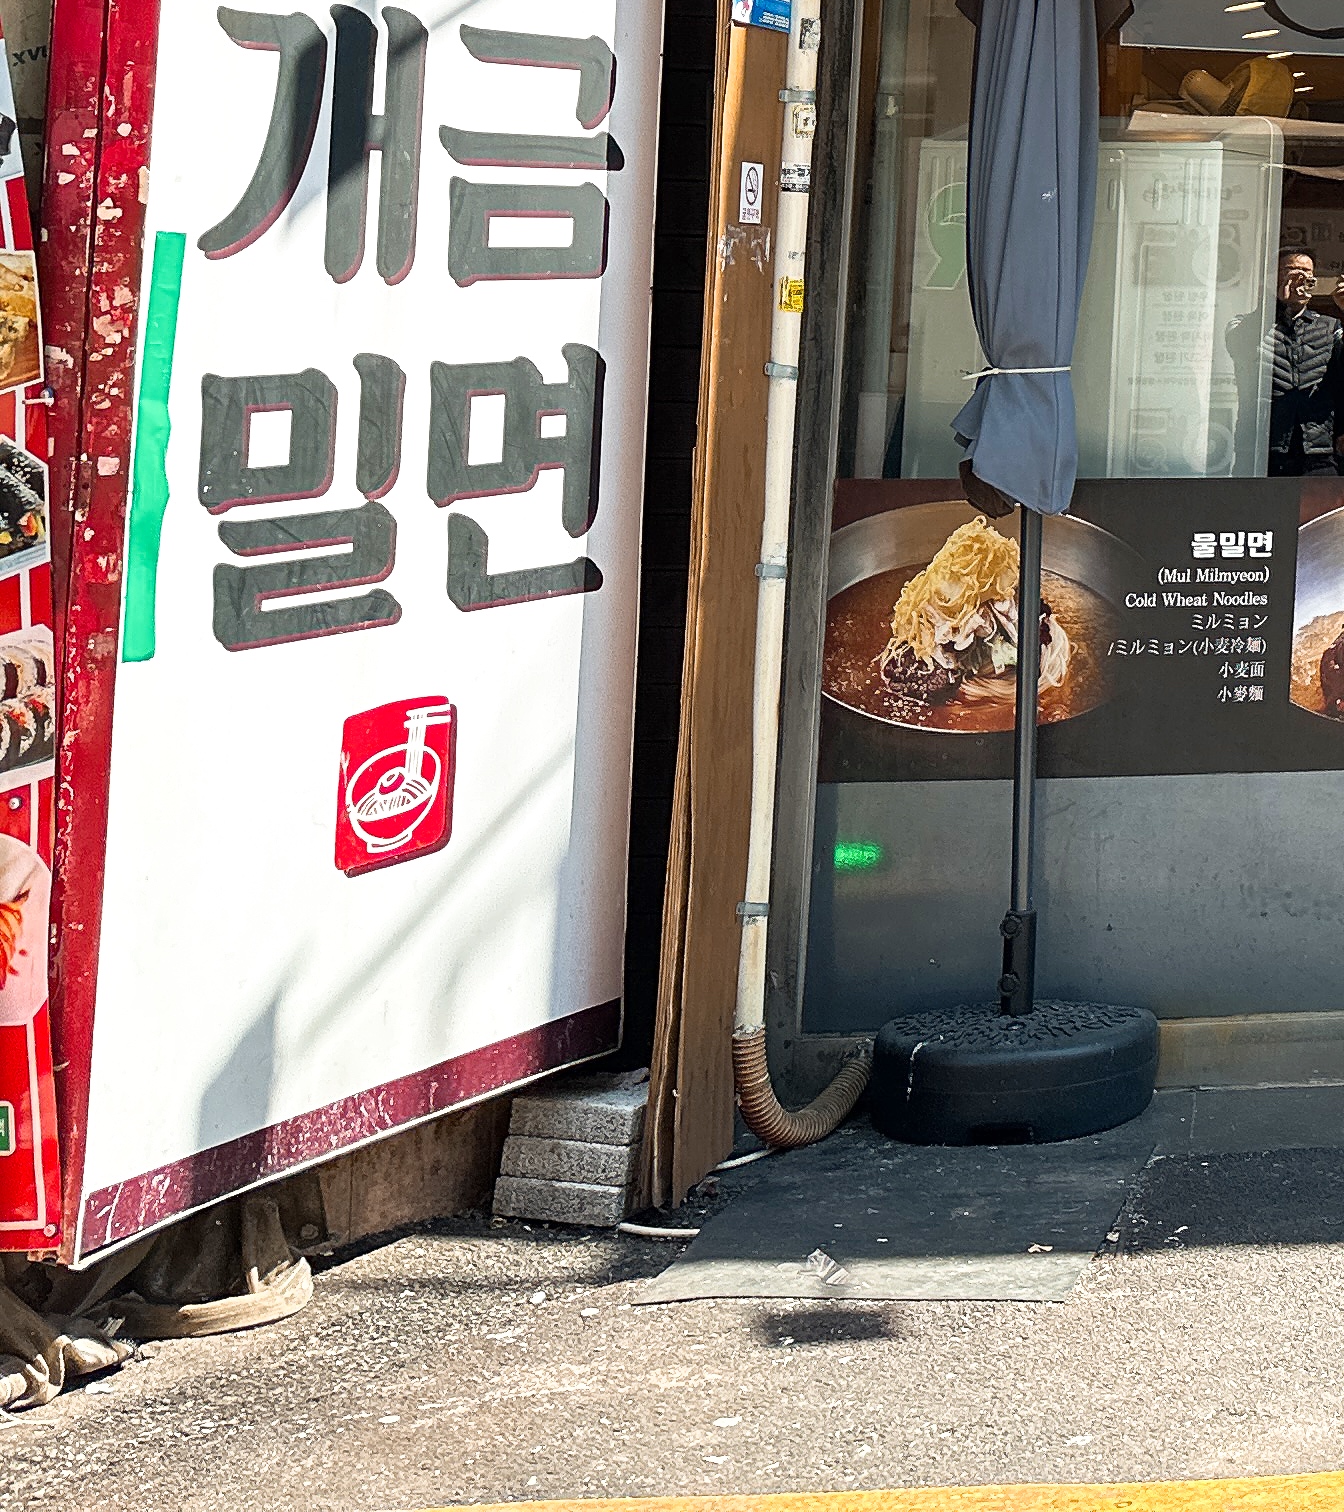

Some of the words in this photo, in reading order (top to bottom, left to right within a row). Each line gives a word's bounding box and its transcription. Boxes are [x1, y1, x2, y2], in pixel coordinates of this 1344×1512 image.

[197, 4, 625, 288] 개금
[197, 343, 604, 652] 밀면
[1191, 531, 1273, 558] 물밀면
[1157, 566, 1191, 585] (Mul
[1195, 565, 1270, 585] Milmyeon)
[1125, 592, 1157, 608] Cold
[1162, 592, 1208, 607] Wheat
[1212, 591, 1268, 606] Noodles
